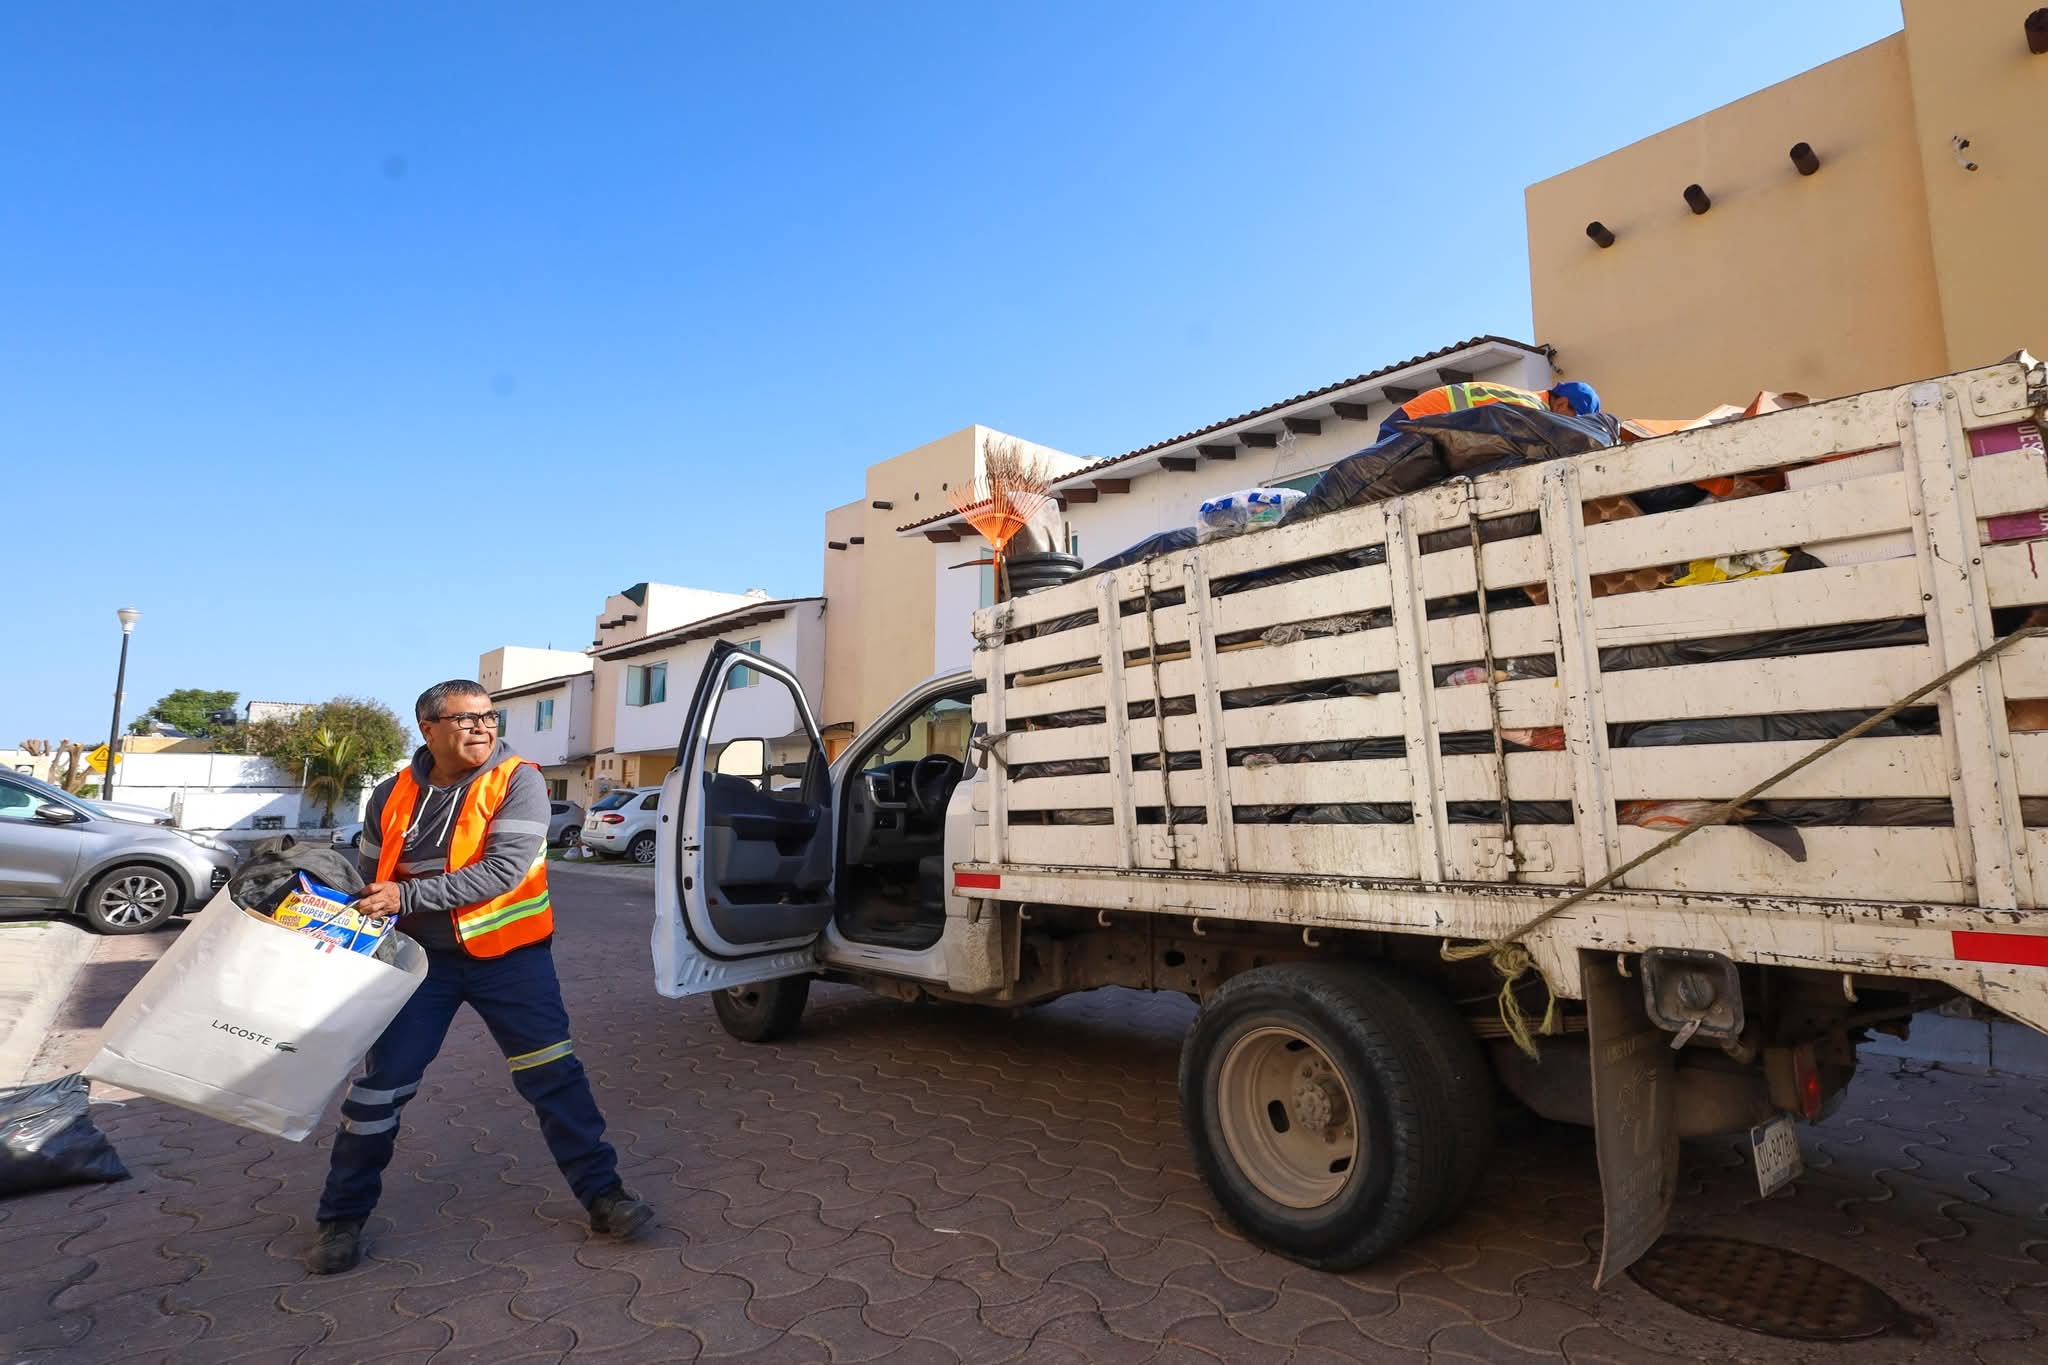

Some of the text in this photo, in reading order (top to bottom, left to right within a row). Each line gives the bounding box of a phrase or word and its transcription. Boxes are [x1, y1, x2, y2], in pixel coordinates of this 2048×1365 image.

[301, 895, 328, 910] GRAN
[298, 905, 324, 919] SUPER
[211, 1019, 273, 1046] LACOSTE
